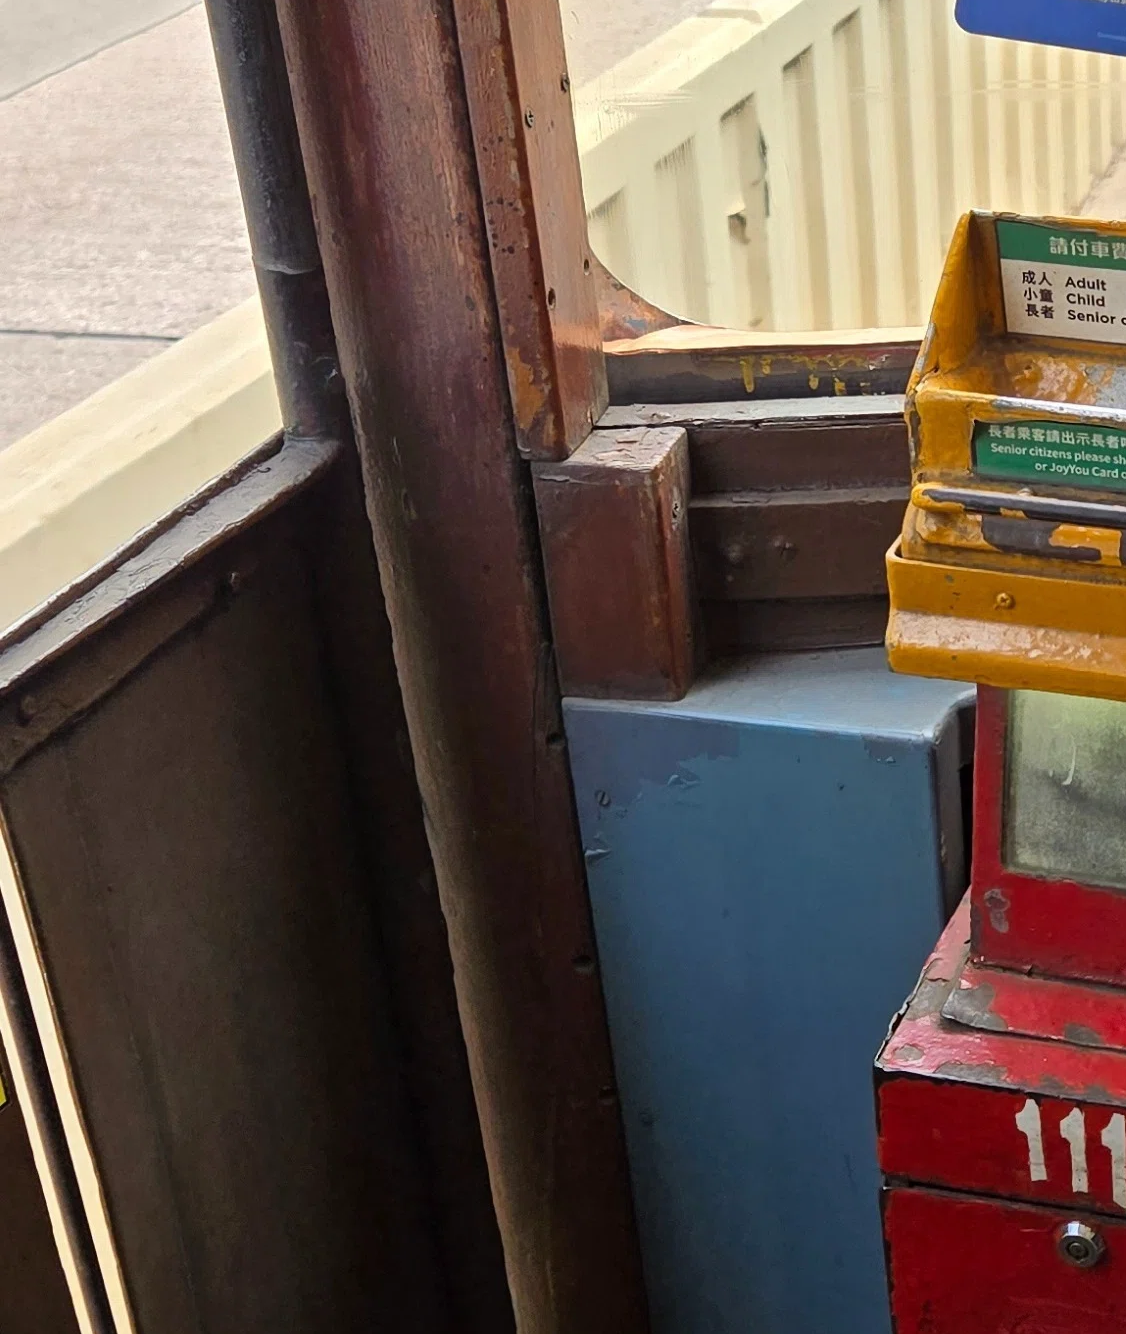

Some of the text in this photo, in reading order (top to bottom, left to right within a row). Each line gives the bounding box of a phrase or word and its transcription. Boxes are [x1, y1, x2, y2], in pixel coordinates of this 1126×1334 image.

[1021, 270, 1107, 292] 成人 Adult
[1023, 287, 1106, 308] 小童 Child
[1025, 303, 1055, 320] 長者
[1067, 308, 1116, 326] Senior
[990, 443, 1028, 455] Senior
[1028, 446, 1072, 460] citizens
[1074, 450, 1110, 464] please
[1034, 462, 1048, 471] or
[1049, 463, 1090, 476] JoyYou
[1091, 467, 1118, 479] Card
